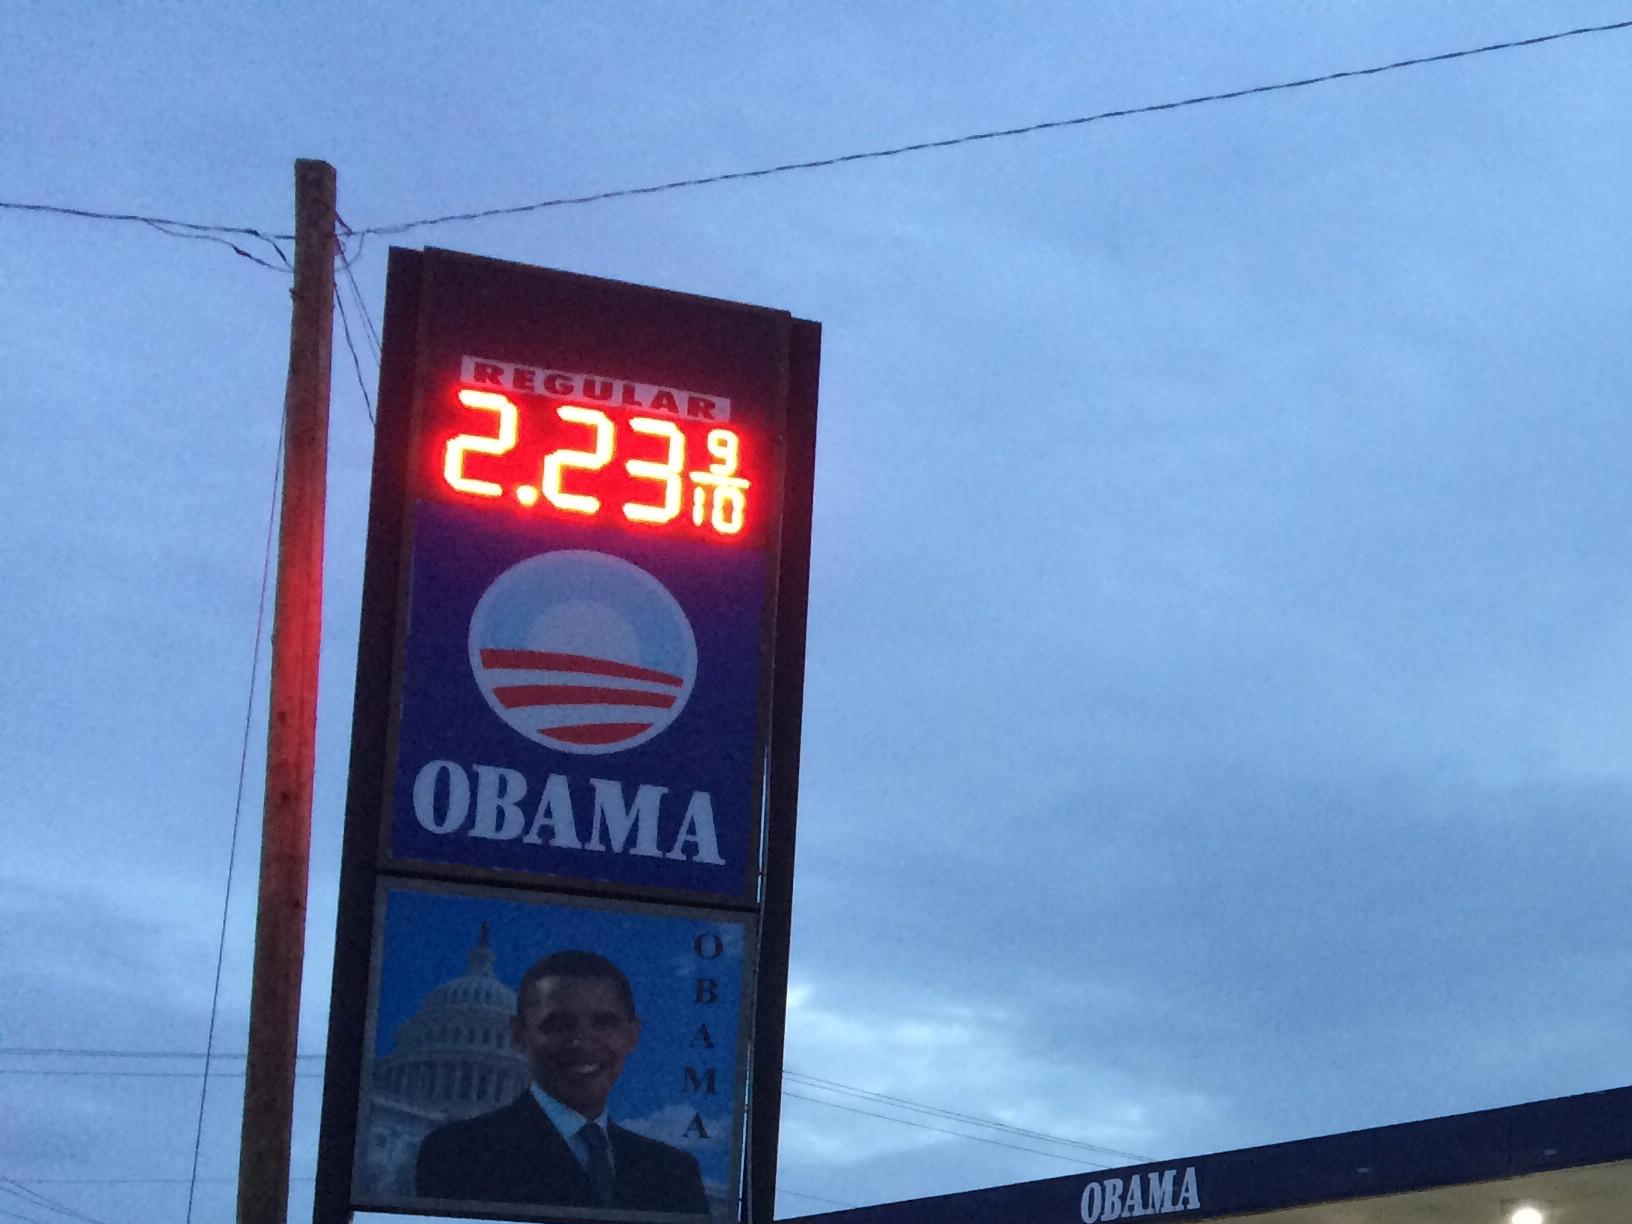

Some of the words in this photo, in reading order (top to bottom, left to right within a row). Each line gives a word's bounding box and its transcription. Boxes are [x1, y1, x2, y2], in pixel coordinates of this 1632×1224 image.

[473, 361, 717, 421] REGULAR
[444, 388, 686, 524] 2.23
[412, 758, 726, 866] OBAMA
[1080, 1166, 1200, 1224] OBAMA
